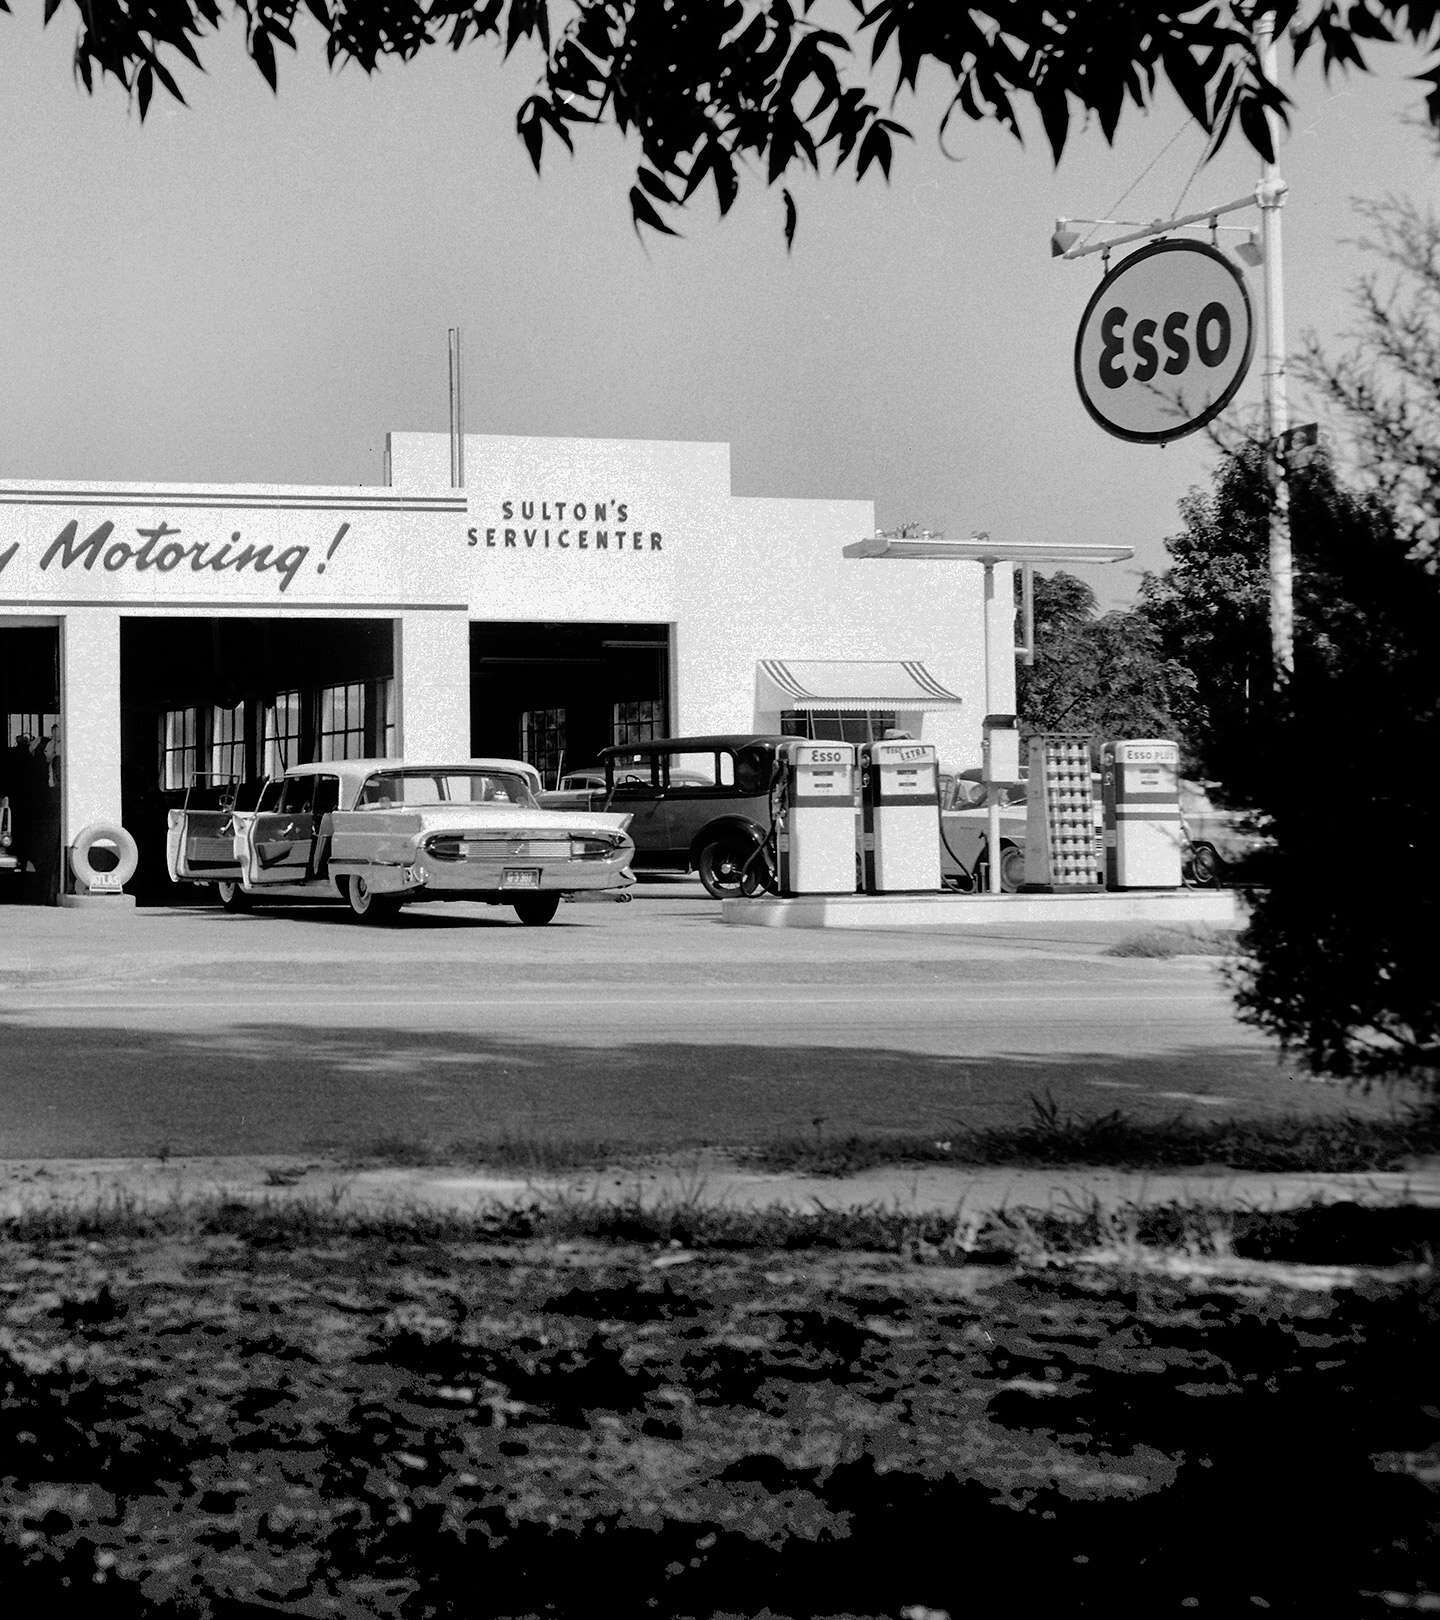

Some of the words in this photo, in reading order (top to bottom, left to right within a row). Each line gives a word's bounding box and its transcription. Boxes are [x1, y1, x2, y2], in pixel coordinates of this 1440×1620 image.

[502, 500, 628, 523] SULTON'S
[467, 528, 663, 551] SERVICENTER
[40, 520, 350, 592] Motoring!
